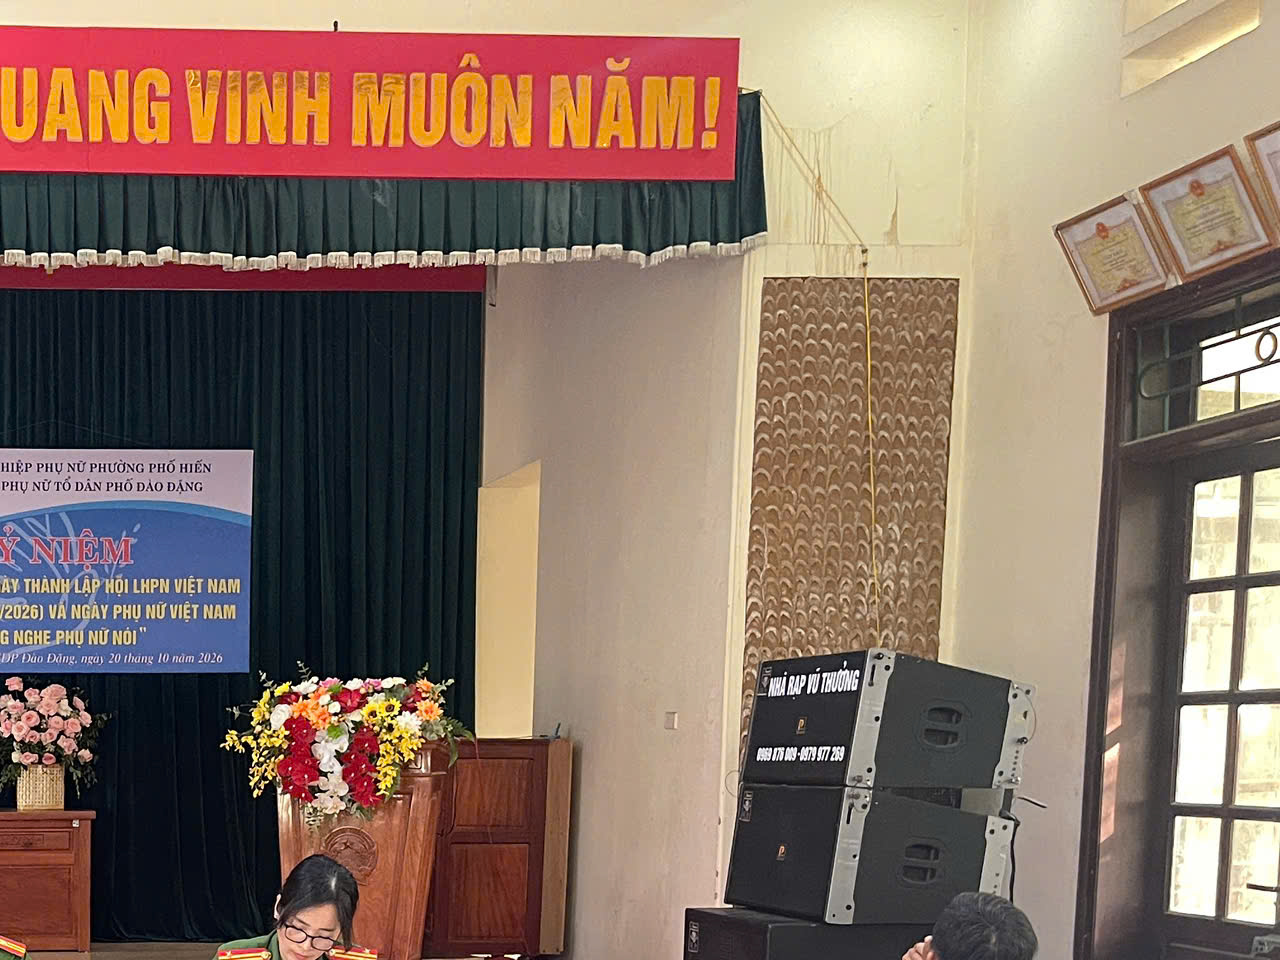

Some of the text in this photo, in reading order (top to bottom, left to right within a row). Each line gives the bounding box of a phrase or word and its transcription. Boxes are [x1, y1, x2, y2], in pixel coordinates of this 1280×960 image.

[185, 69, 331, 147] VINH
[350, 52, 533, 148] MUÔN
[549, 57, 720, 150] NĂM!
[0, 460, 32, 475] HIỆP
[36, 462, 63, 475] PHỤ
[67, 460, 87, 473] NỮ
[89, 459, 145, 473] PHƯỜNG
[148, 459, 176, 473] PHỐ
[179, 459, 212, 473] HIẾN
[1, 480, 28, 494] PHỤ
[32, 479, 52, 492] NỮ
[54, 476, 72, 492] TỔ
[75, 479, 102, 491] DÂN
[106, 478, 134, 492] PHỐ
[167, 479, 203, 494] ĐẶNG
[30, 528, 134, 571] NIỆM
[24, 575, 70, 593] THÀNH
[74, 576, 100, 596] LẬP
[105, 576, 129, 596] HỘI
[133, 578, 170, 593] LHPN
[174, 576, 204, 596] VIỆT
[207, 578, 241, 594] NAM
[71, 602, 109, 619] NGÀY
[112, 604, 141, 622] PHỤ
[145, 602, 167, 619] NỮ
[170, 602, 199, 622] VIỆT
[203, 604, 236, 619] NAM
[13, 630, 51, 645] NGHE
[55, 630, 84, 648] PHỤ
[88, 627, 110, 645] NỮ
[80, 653, 104, 665] ngày
[108, 652, 121, 664] 20
[123, 652, 154, 665] tháng
[157, 652, 169, 663] 10
[172, 653, 195, 664] năm
[198, 652, 223, 664] 2026
